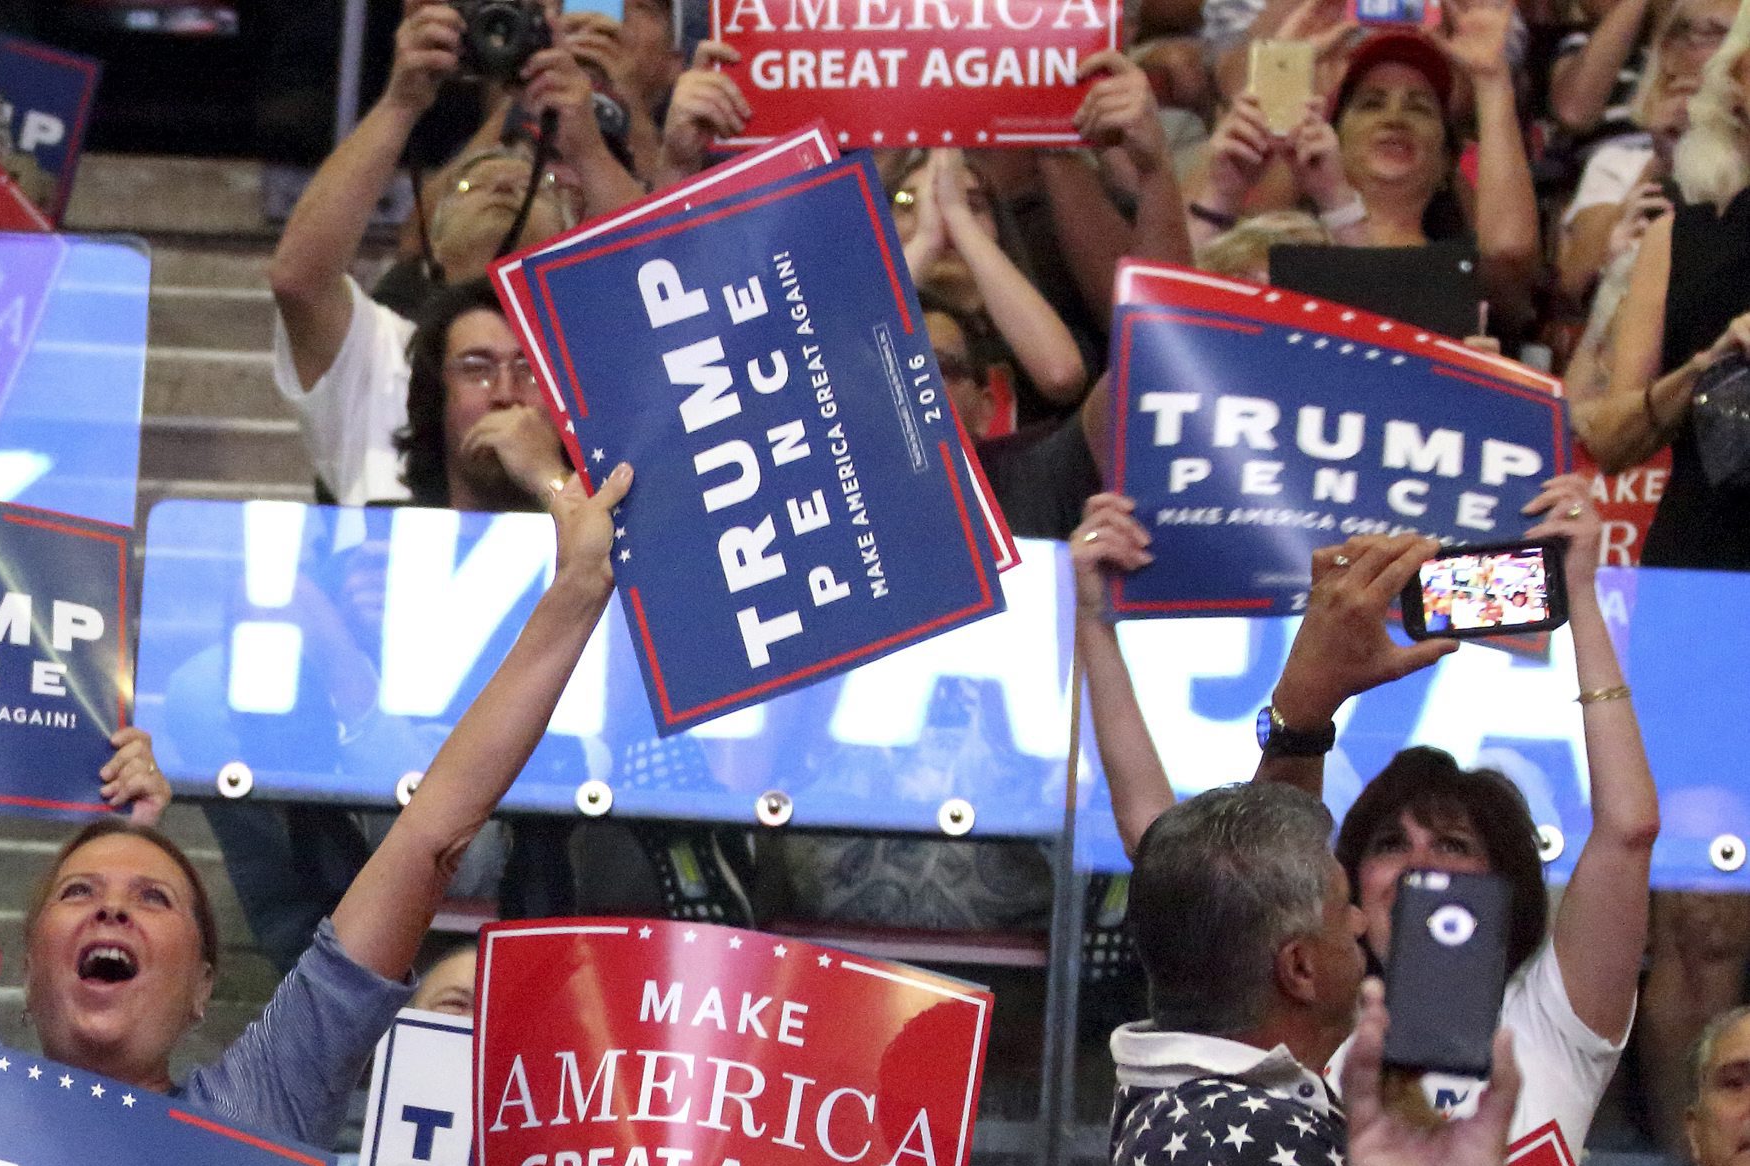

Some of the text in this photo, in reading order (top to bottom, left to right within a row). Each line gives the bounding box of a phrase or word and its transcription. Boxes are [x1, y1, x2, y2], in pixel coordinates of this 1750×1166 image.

[752, 47, 1078, 89] GREAT AGAIN
[773, 251, 889, 598] MAKE AMERICA GREAT AGAIN!
[909, 354, 942, 424] 2016
[638, 258, 803, 669] TRUMP
[722, 275, 851, 607] PENCE
[1140, 392, 1543, 485] TRUMP
[1157, 507, 1223, 526] MAKE
[1226, 507, 1336, 531] AMERICA
[1170, 457, 1499, 530] PENCE
[1589, 469, 1666, 504] AKE
[639, 979, 809, 1047] MAKE
